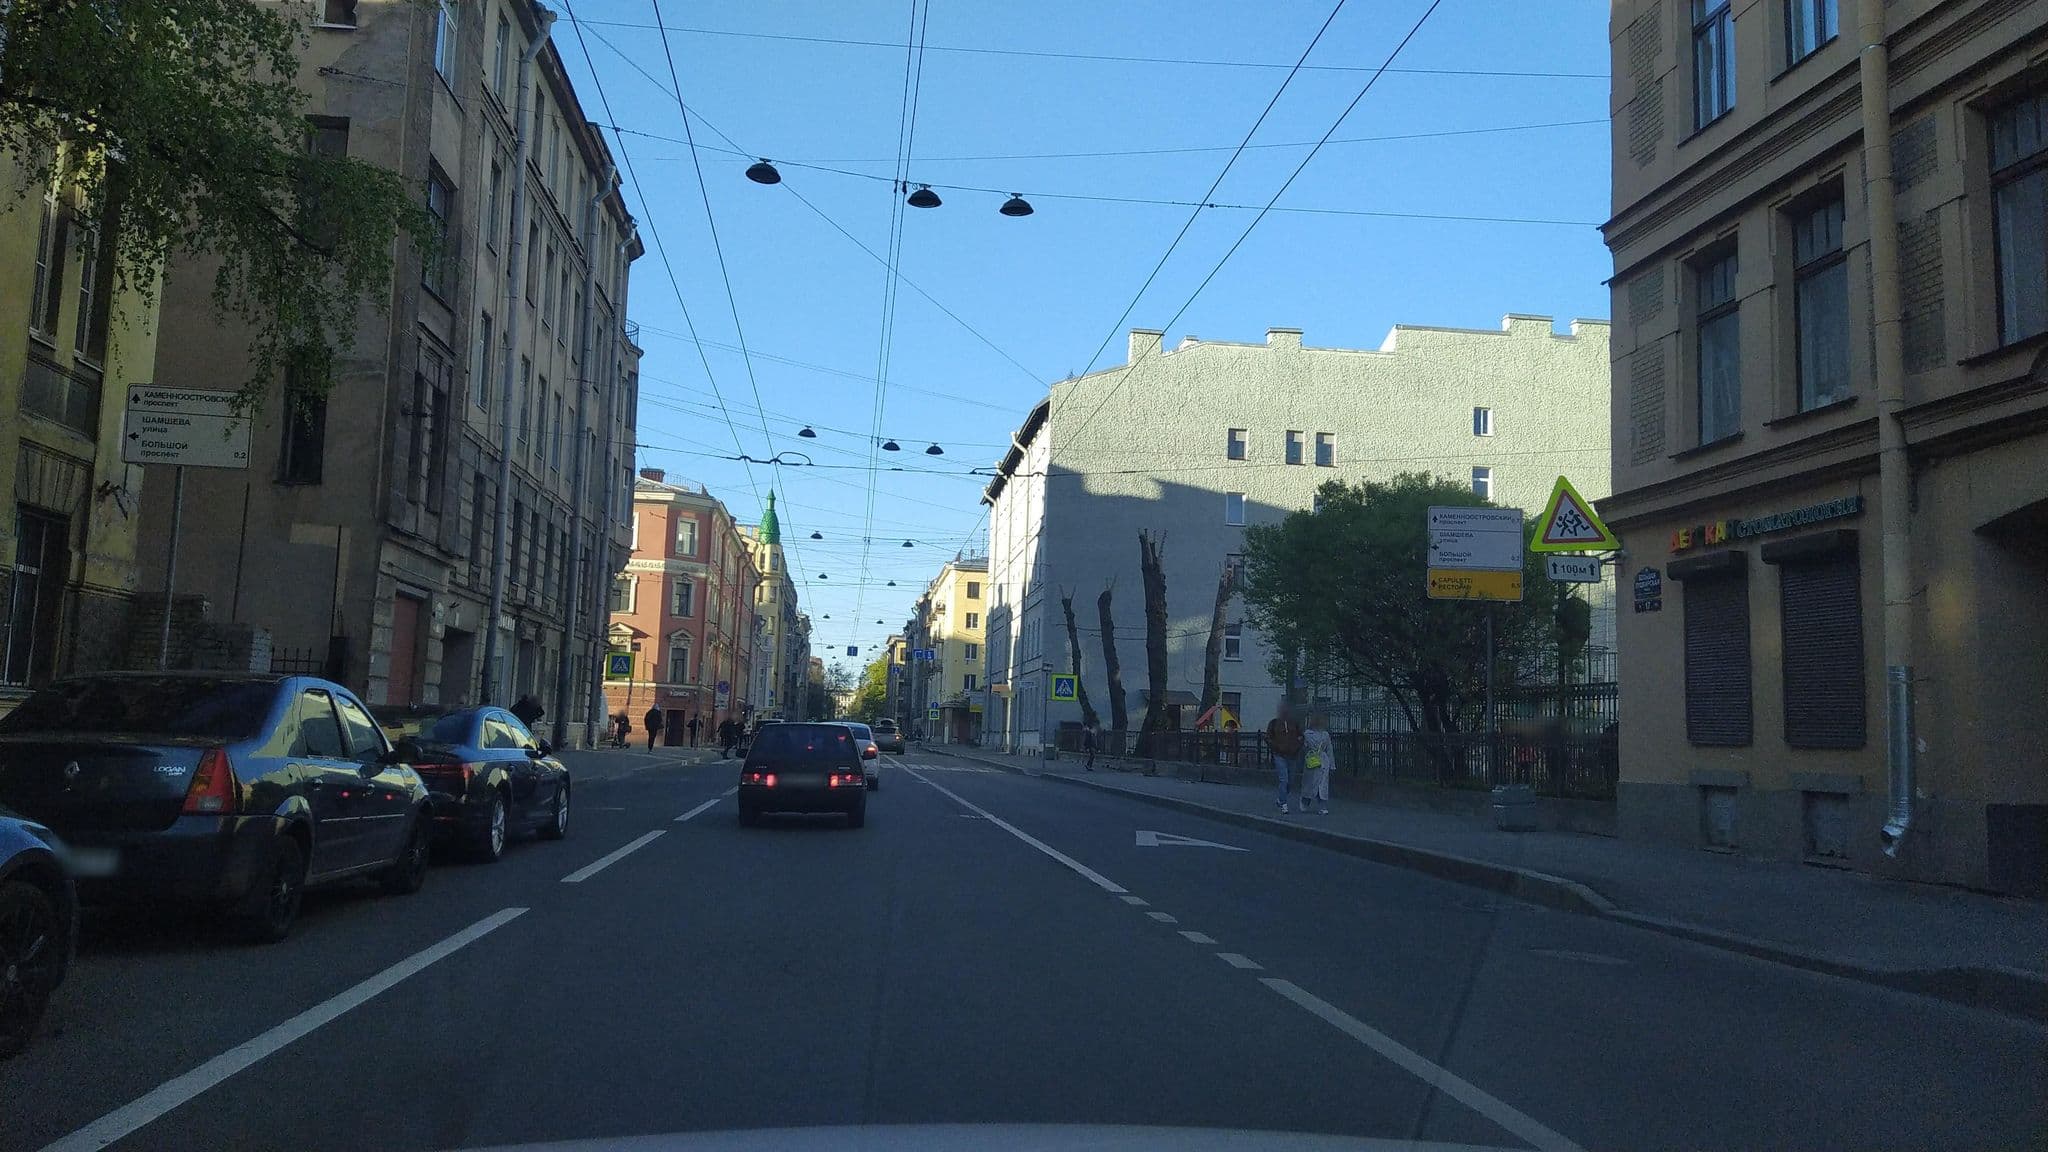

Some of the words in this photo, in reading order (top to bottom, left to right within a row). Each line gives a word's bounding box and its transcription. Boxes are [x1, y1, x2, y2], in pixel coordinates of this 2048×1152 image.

[142, 416, 191, 426] ШАМШЕВА
[142, 426, 168, 434] улица
[141, 440, 188, 450] БОЛЬШОЙ
[140, 450, 179, 458] проспект
